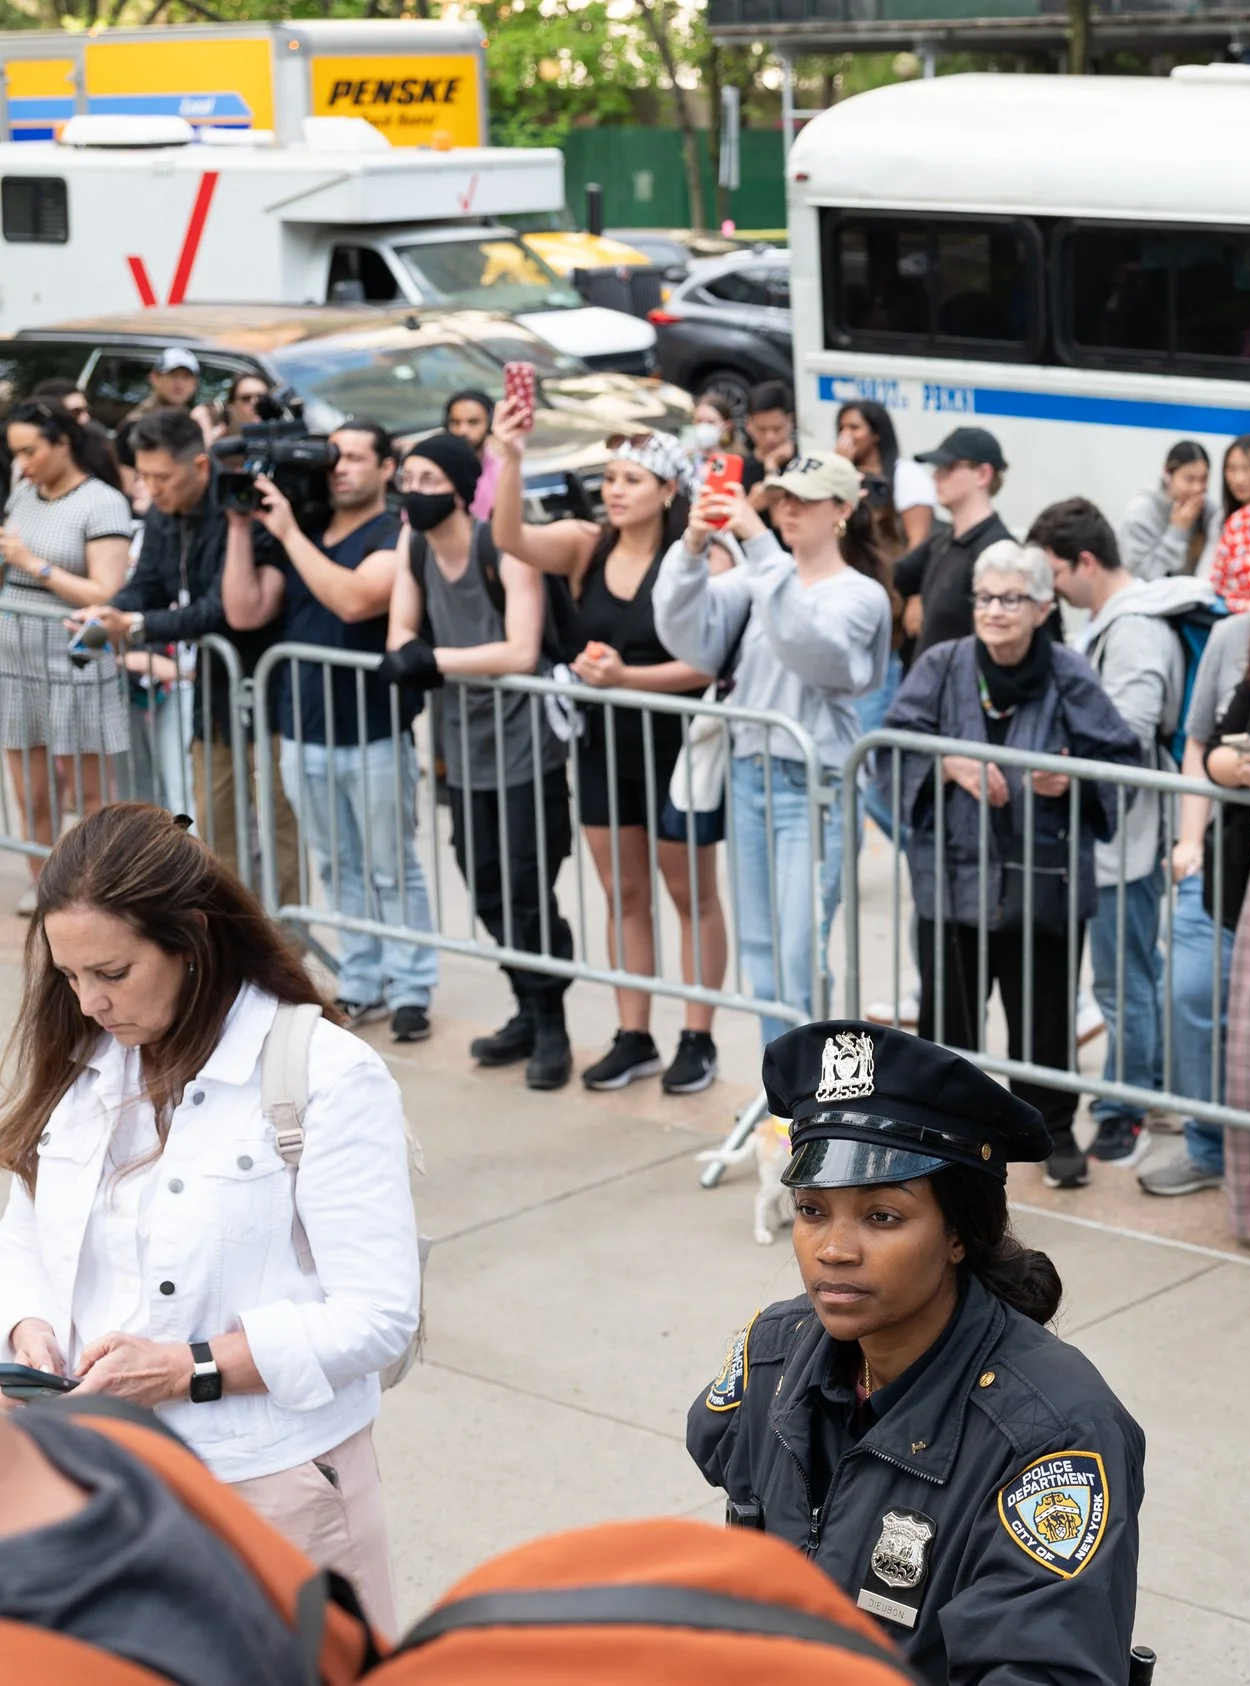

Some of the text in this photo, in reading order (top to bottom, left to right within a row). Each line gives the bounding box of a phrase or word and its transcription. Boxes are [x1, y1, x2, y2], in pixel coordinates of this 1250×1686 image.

[328, 76, 462, 107] PENSKE
[1022, 1460, 1073, 1485] POLICE
[1007, 1473, 1095, 1508] DEPARTMENT
[1011, 1520, 1056, 1561] CITY OF
[1075, 1492, 1103, 1561] NEW YORK
[868, 1598, 905, 1619] DIEUBON
